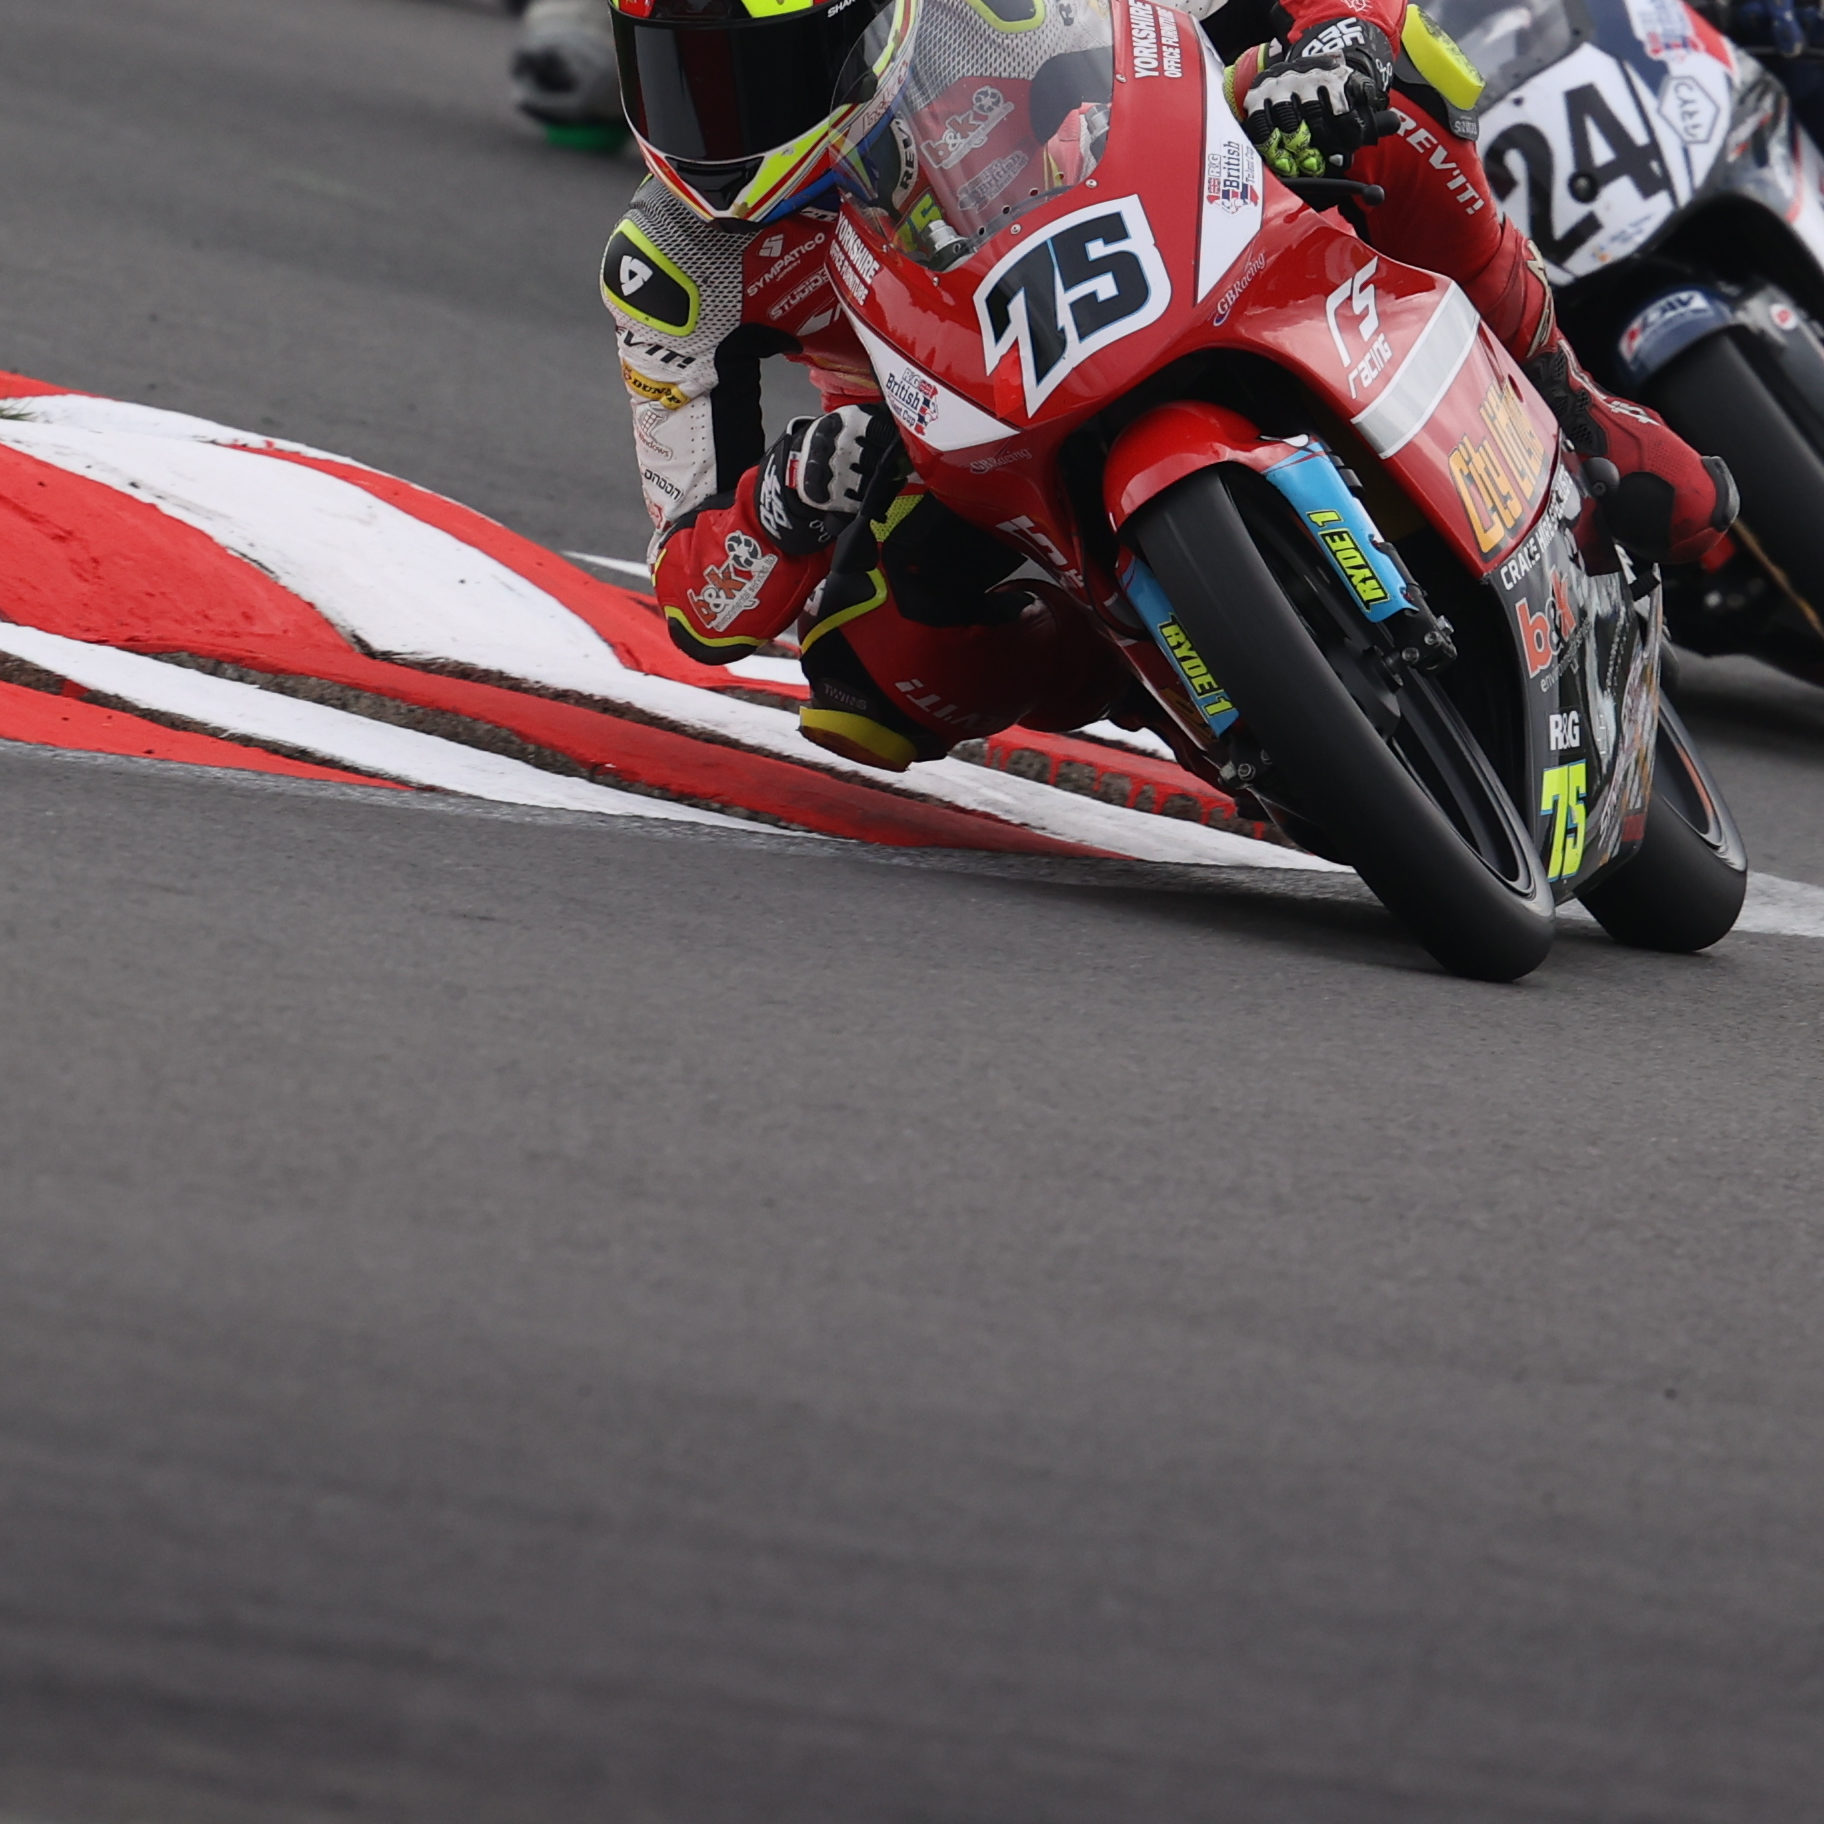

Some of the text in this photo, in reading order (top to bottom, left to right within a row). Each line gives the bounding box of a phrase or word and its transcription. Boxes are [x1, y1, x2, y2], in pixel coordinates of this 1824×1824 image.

[1157, 6, 1182, 78] OFFICE FURNITURE
[921, 112, 982, 169] b&k
[1223, 140, 1240, 190] British
[1485, 83, 1670, 265] 24
[746, 232, 826, 297] SYMPATICO
[834, 211, 881, 285] YORKSHIRE
[985, 211, 1152, 387] 75
[632, 379, 681, 404] DUNOP
[885, 373, 921, 410] British
[687, 562, 752, 628] b&k
[1318, 528, 1391, 613] RYDE
[1158, 613, 1222, 698] RYDE
[1549, 710, 1581, 752] R&G
[1540, 759, 1588, 882] 75
